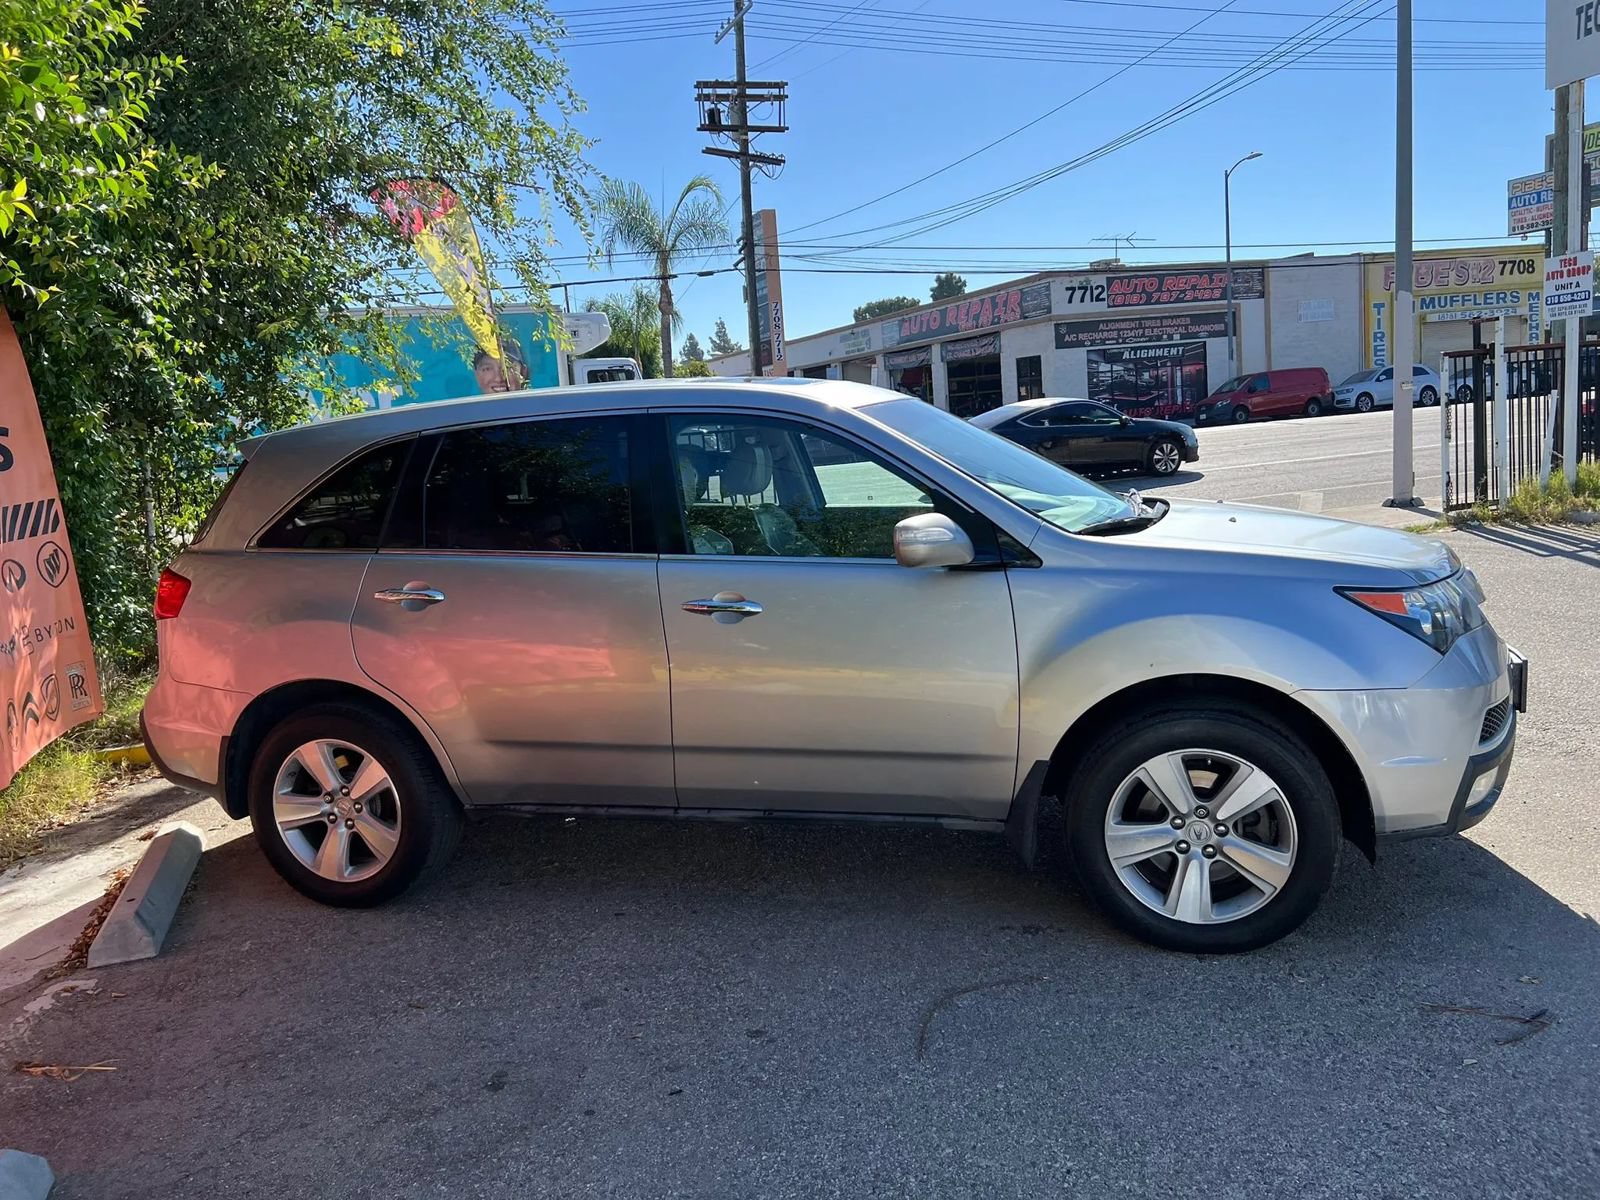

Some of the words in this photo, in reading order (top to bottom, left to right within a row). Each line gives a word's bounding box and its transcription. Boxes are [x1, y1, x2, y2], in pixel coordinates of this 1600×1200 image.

[1510, 193, 1538, 208] AUTO
[1498, 259, 1535, 276] 7708
[1559, 256, 1577, 268] TECH
[1546, 270, 1564, 281] AUTO
[1566, 265, 1591, 277] GROUP
[1065, 284, 1106, 304] 7712
[1109, 278, 1157, 294] AUTO
[1554, 282, 1573, 292] UNIT
[1575, 281, 1580, 289] A
[1420, 291, 1521, 311] MUFFLERS
[773, 301, 781, 330] 7708
[902, 311, 940, 336] AUTO
[946, 290, 1021, 326] REPAIR
[1064, 333, 1077, 342] A/C
[1078, 331, 1118, 341] RECHARGE
[1119, 328, 1143, 339] 1234YF
[1144, 326, 1187, 336] ELECTRICAL
[1188, 322, 1225, 333] DIAGNOSIS
[1098, 321, 1139, 331] ALIGNMENT
[1140, 319, 1160, 329] TIRES
[1162, 317, 1191, 326] BRAKES
[1372, 302, 1386, 369] TIRES
[775, 333, 784, 361] 7712
[1122, 346, 1184, 360] ALIGNMENT
